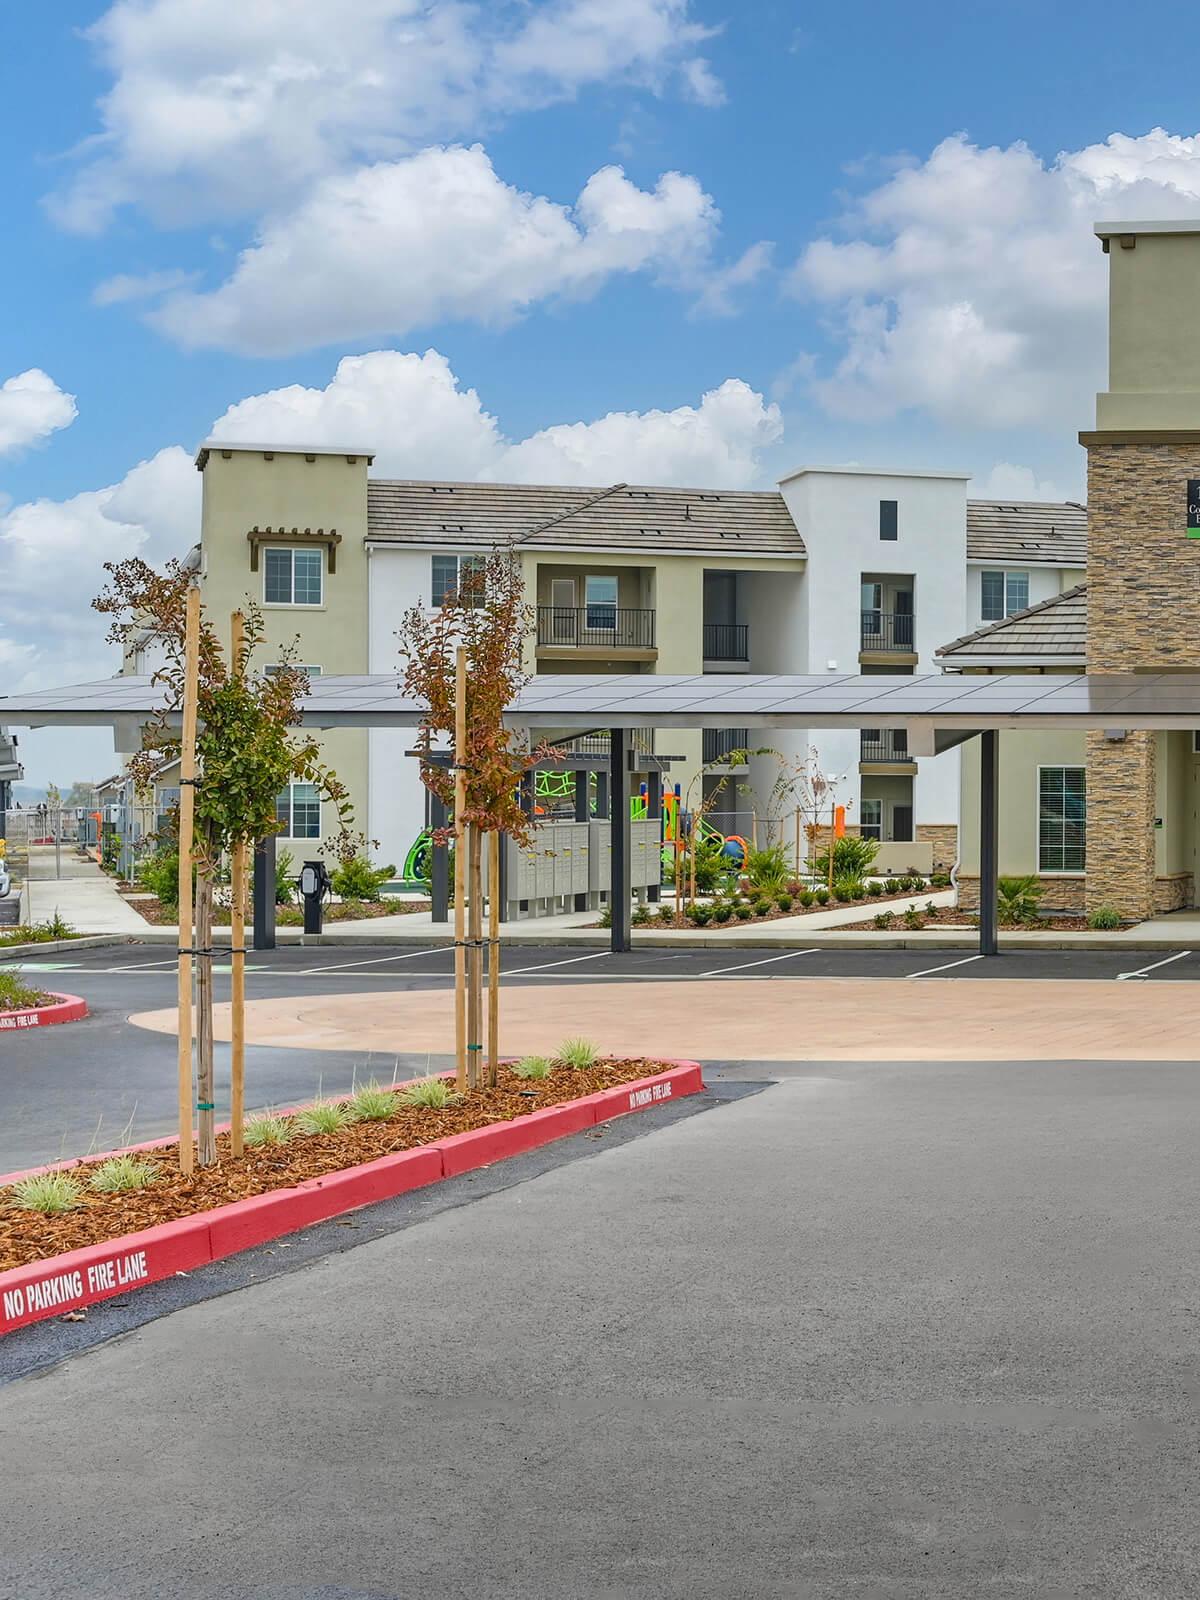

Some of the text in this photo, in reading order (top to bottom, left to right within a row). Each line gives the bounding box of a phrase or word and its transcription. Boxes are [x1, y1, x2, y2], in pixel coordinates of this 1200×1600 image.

[0, 1014, 39, 1028] ARKING FIRE LANE
[636, 1087, 652, 1106] PARKING
[653, 1084, 662, 1100] FIRE
[662, 1081, 672, 1097] LANE
[3, 1251, 148, 1320] NO PARKING FIRE LANE
